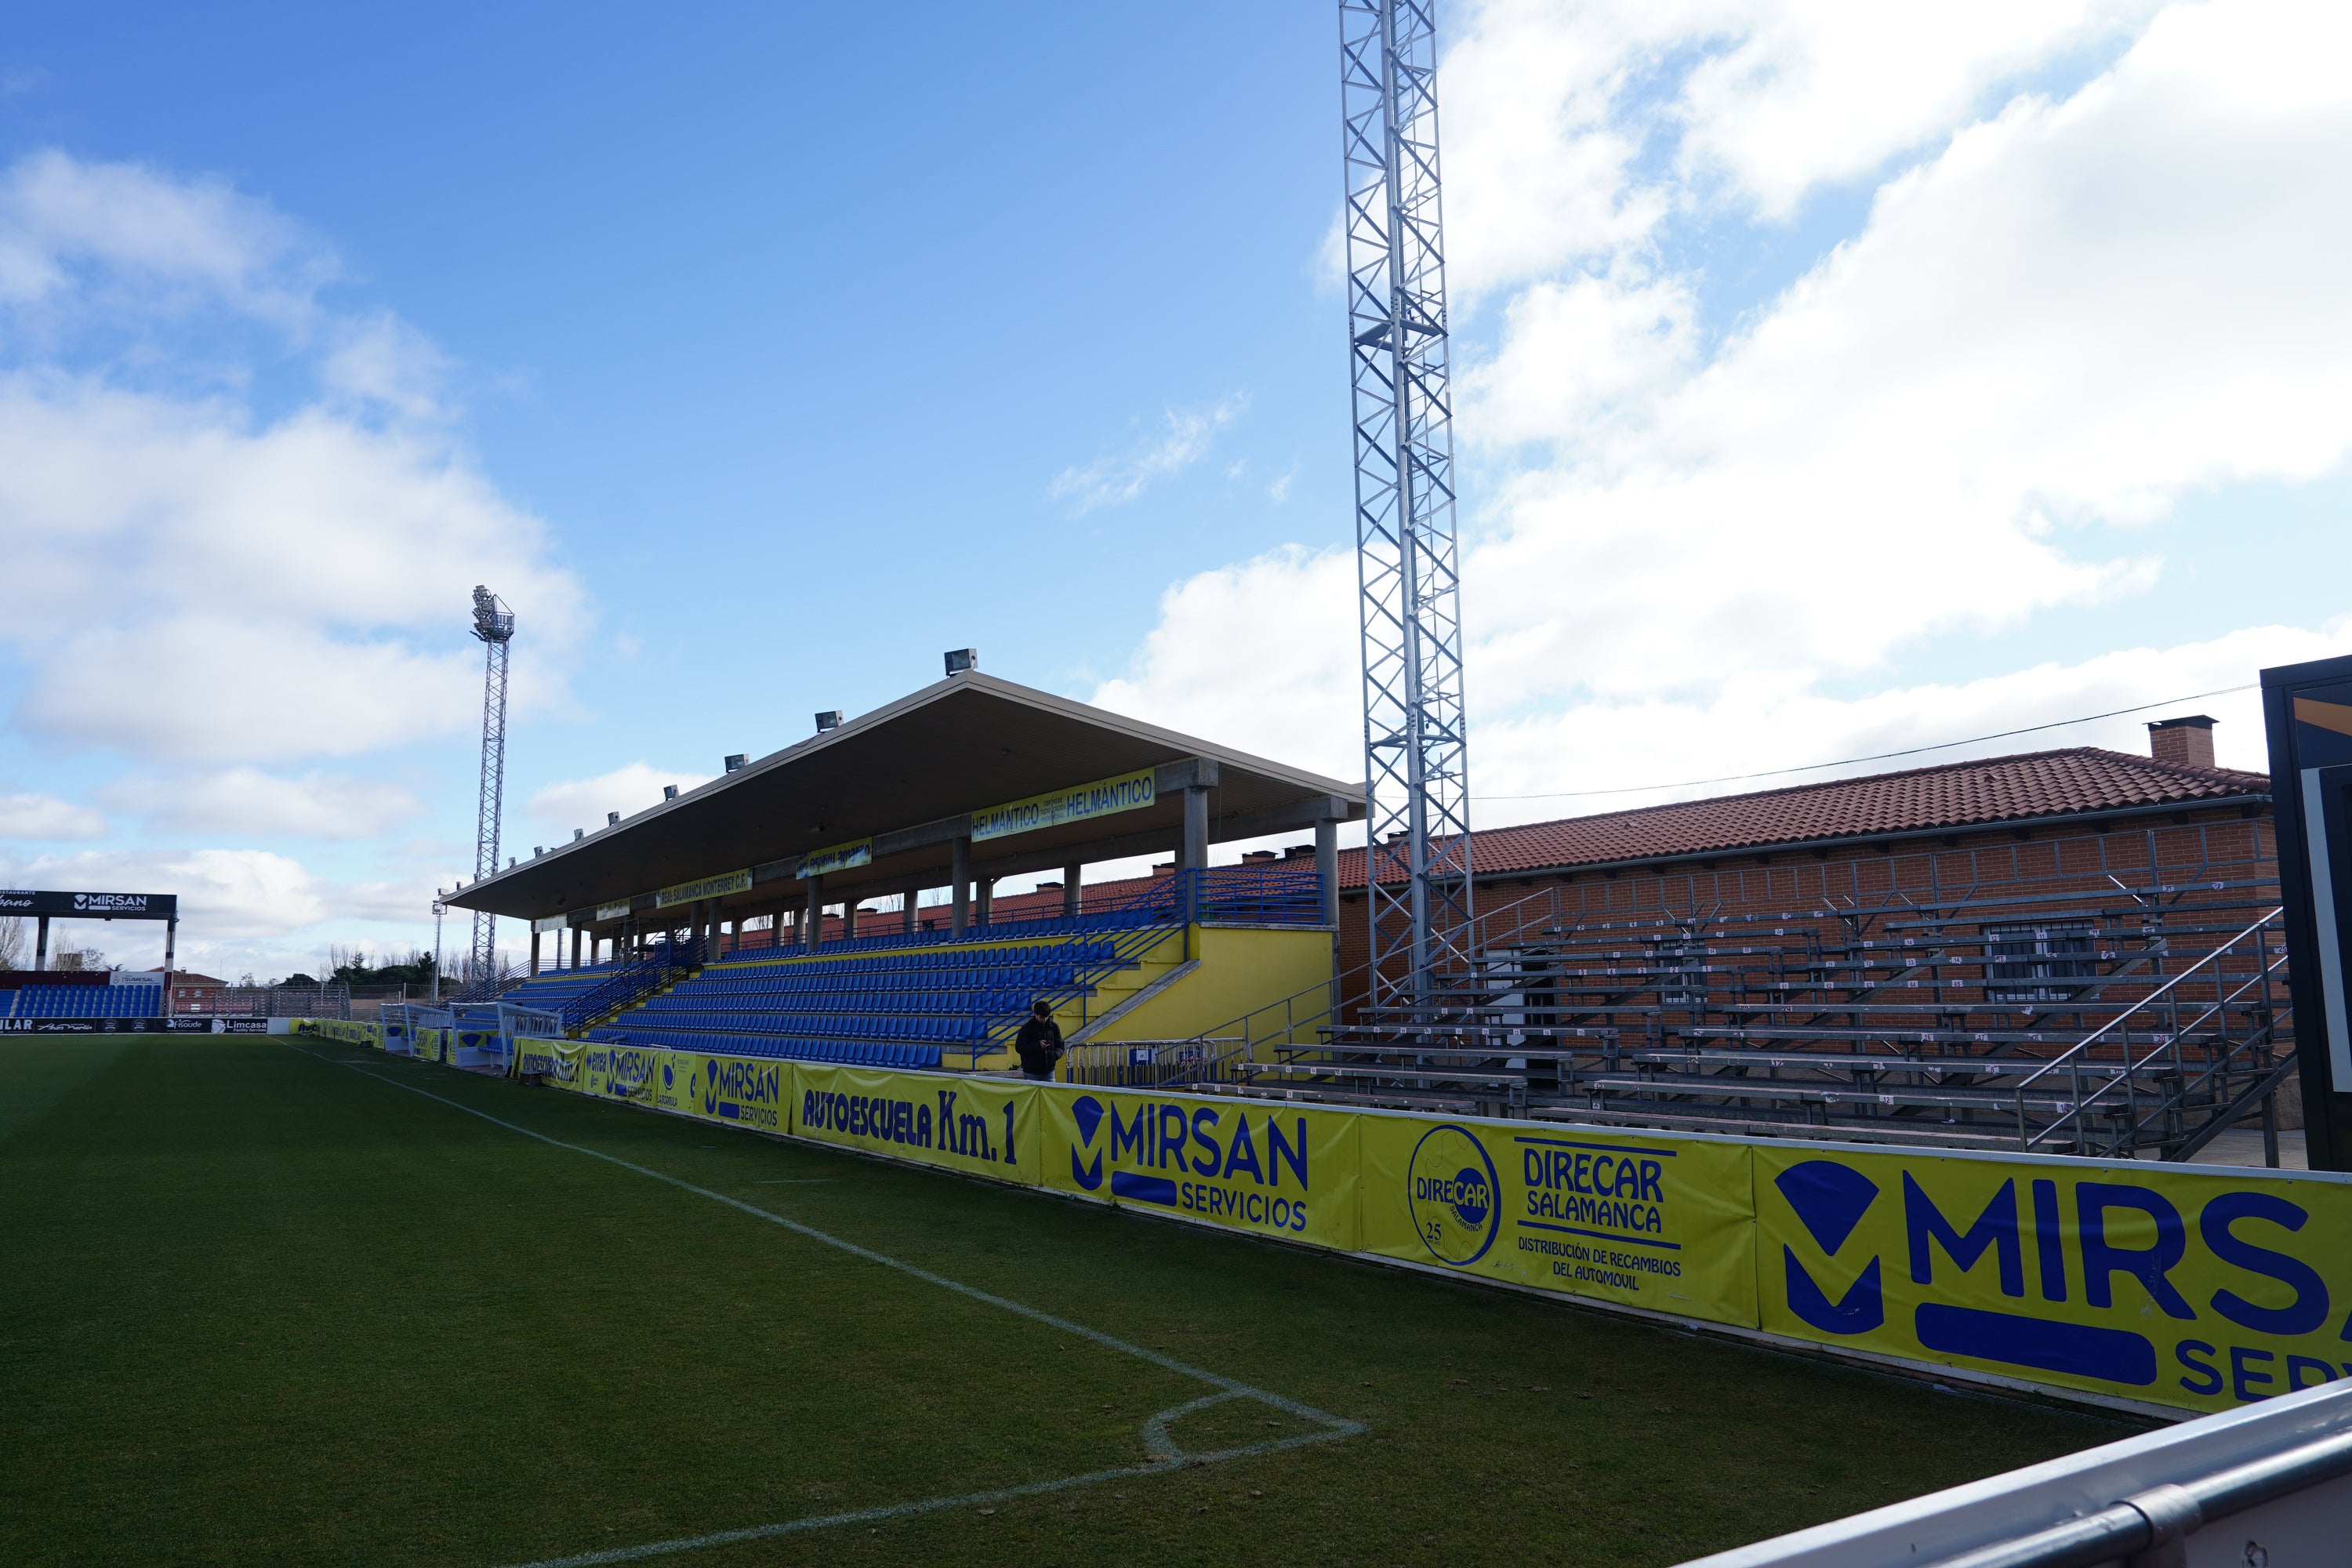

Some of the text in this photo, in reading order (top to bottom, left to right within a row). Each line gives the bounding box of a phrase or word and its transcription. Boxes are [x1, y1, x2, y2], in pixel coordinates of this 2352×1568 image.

[1067, 776, 1152, 818] HELMÁNTICO
[972, 803, 1039, 838] HELMÁNTICO
[88, 895, 147, 907] MIRSAN
[673, 884, 702, 902] SALAMANCA
[703, 876, 734, 895] MONTERREY
[227, 1019, 267, 1029] Limcasa
[591, 1052, 607, 1073] errea
[615, 1051, 655, 1084] MIRSAN
[627, 1086, 652, 1102] SERVICIOS
[719, 1062, 779, 1105] MIRSAN
[740, 1105, 778, 1126] SERVICIOS
[802, 1089, 931, 1149] AUTOESCUELA
[1110, 1099, 1308, 1192] MIRSAN
[1523, 1148, 1664, 1203] DIRECAR
[1181, 1181, 1307, 1232] SERVICIOS
[1417, 1177, 1489, 1209] DIRECAR
[1450, 1205, 1483, 1232] SALAMANCA
[1527, 1190, 1661, 1233] SALAMANCA
[1426, 1221, 1442, 1240] 25
[1519, 1236, 1681, 1277] DISTRIBUCIÓN DE RECAMBIOS
[1902, 1169, 2352, 1341] MIRS
[1554, 1261, 1639, 1290] DEL AUTOMOVIL
